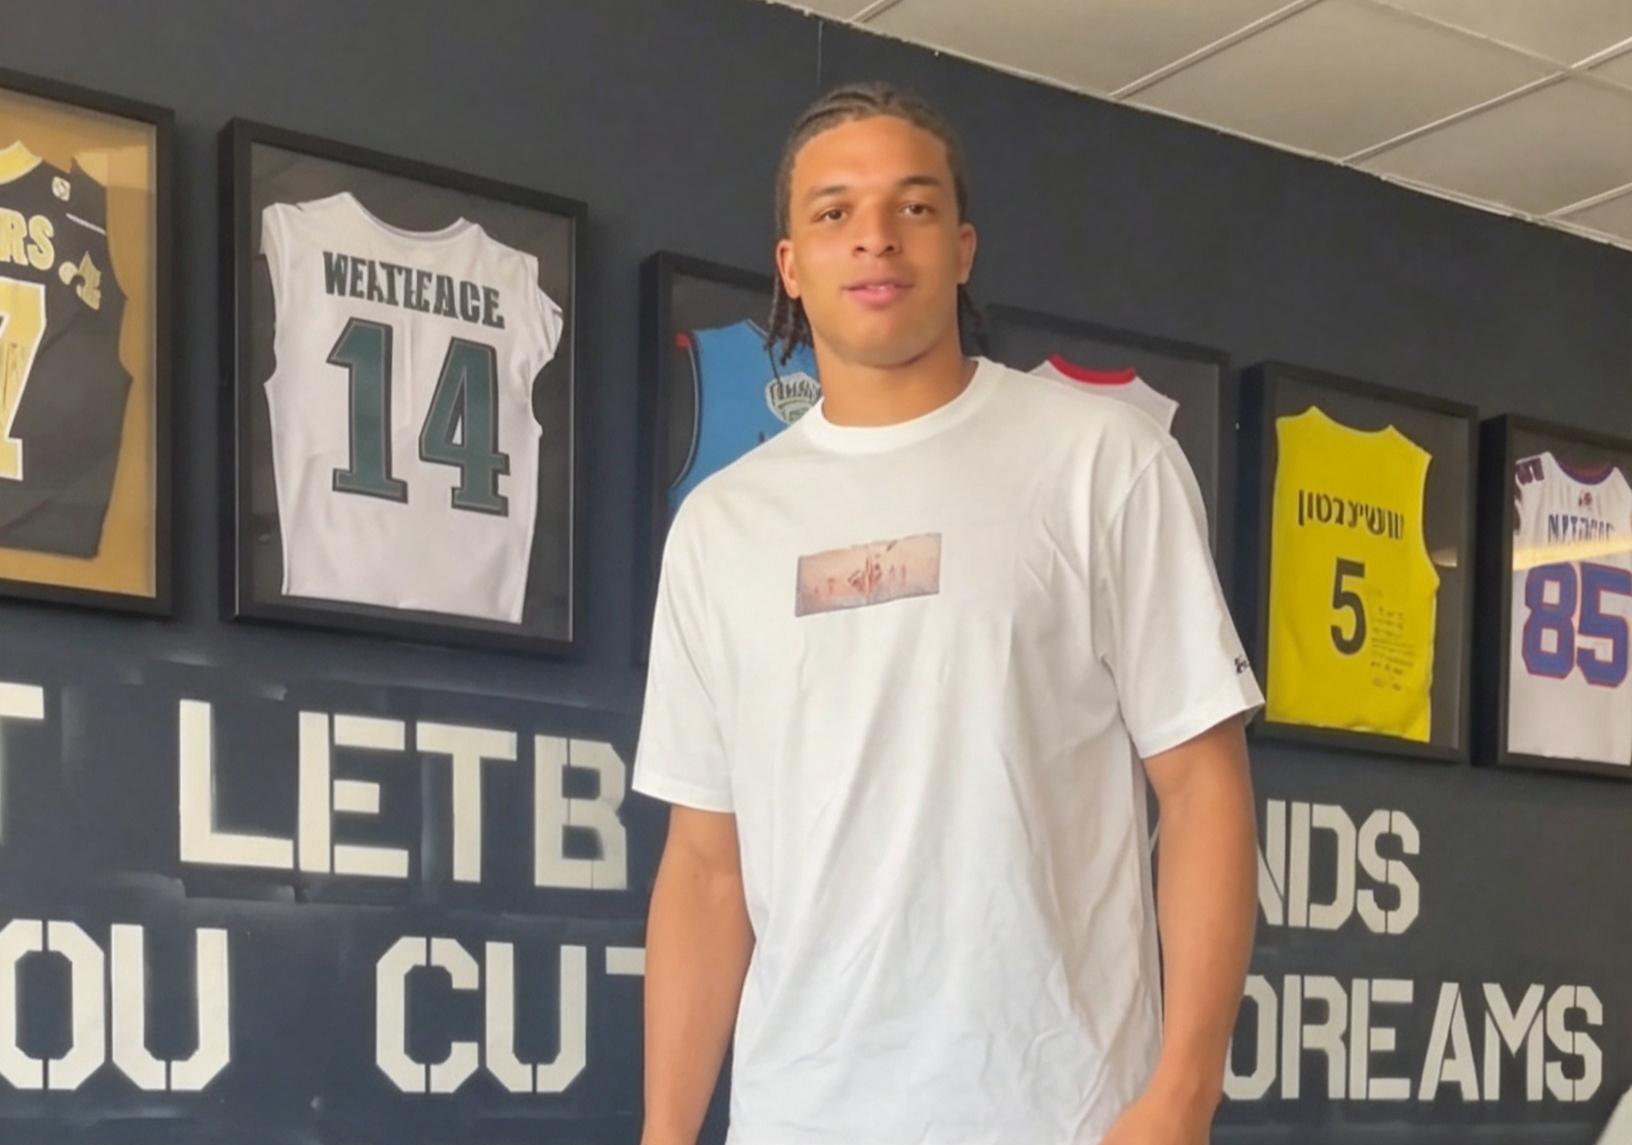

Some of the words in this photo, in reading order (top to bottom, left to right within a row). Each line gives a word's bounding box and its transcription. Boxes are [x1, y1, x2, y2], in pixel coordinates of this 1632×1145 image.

[326, 316, 510, 517] 14
[1330, 557, 1367, 655] 5
[1522, 561, 1632, 688] 85
[376, 936, 646, 1094] CU
